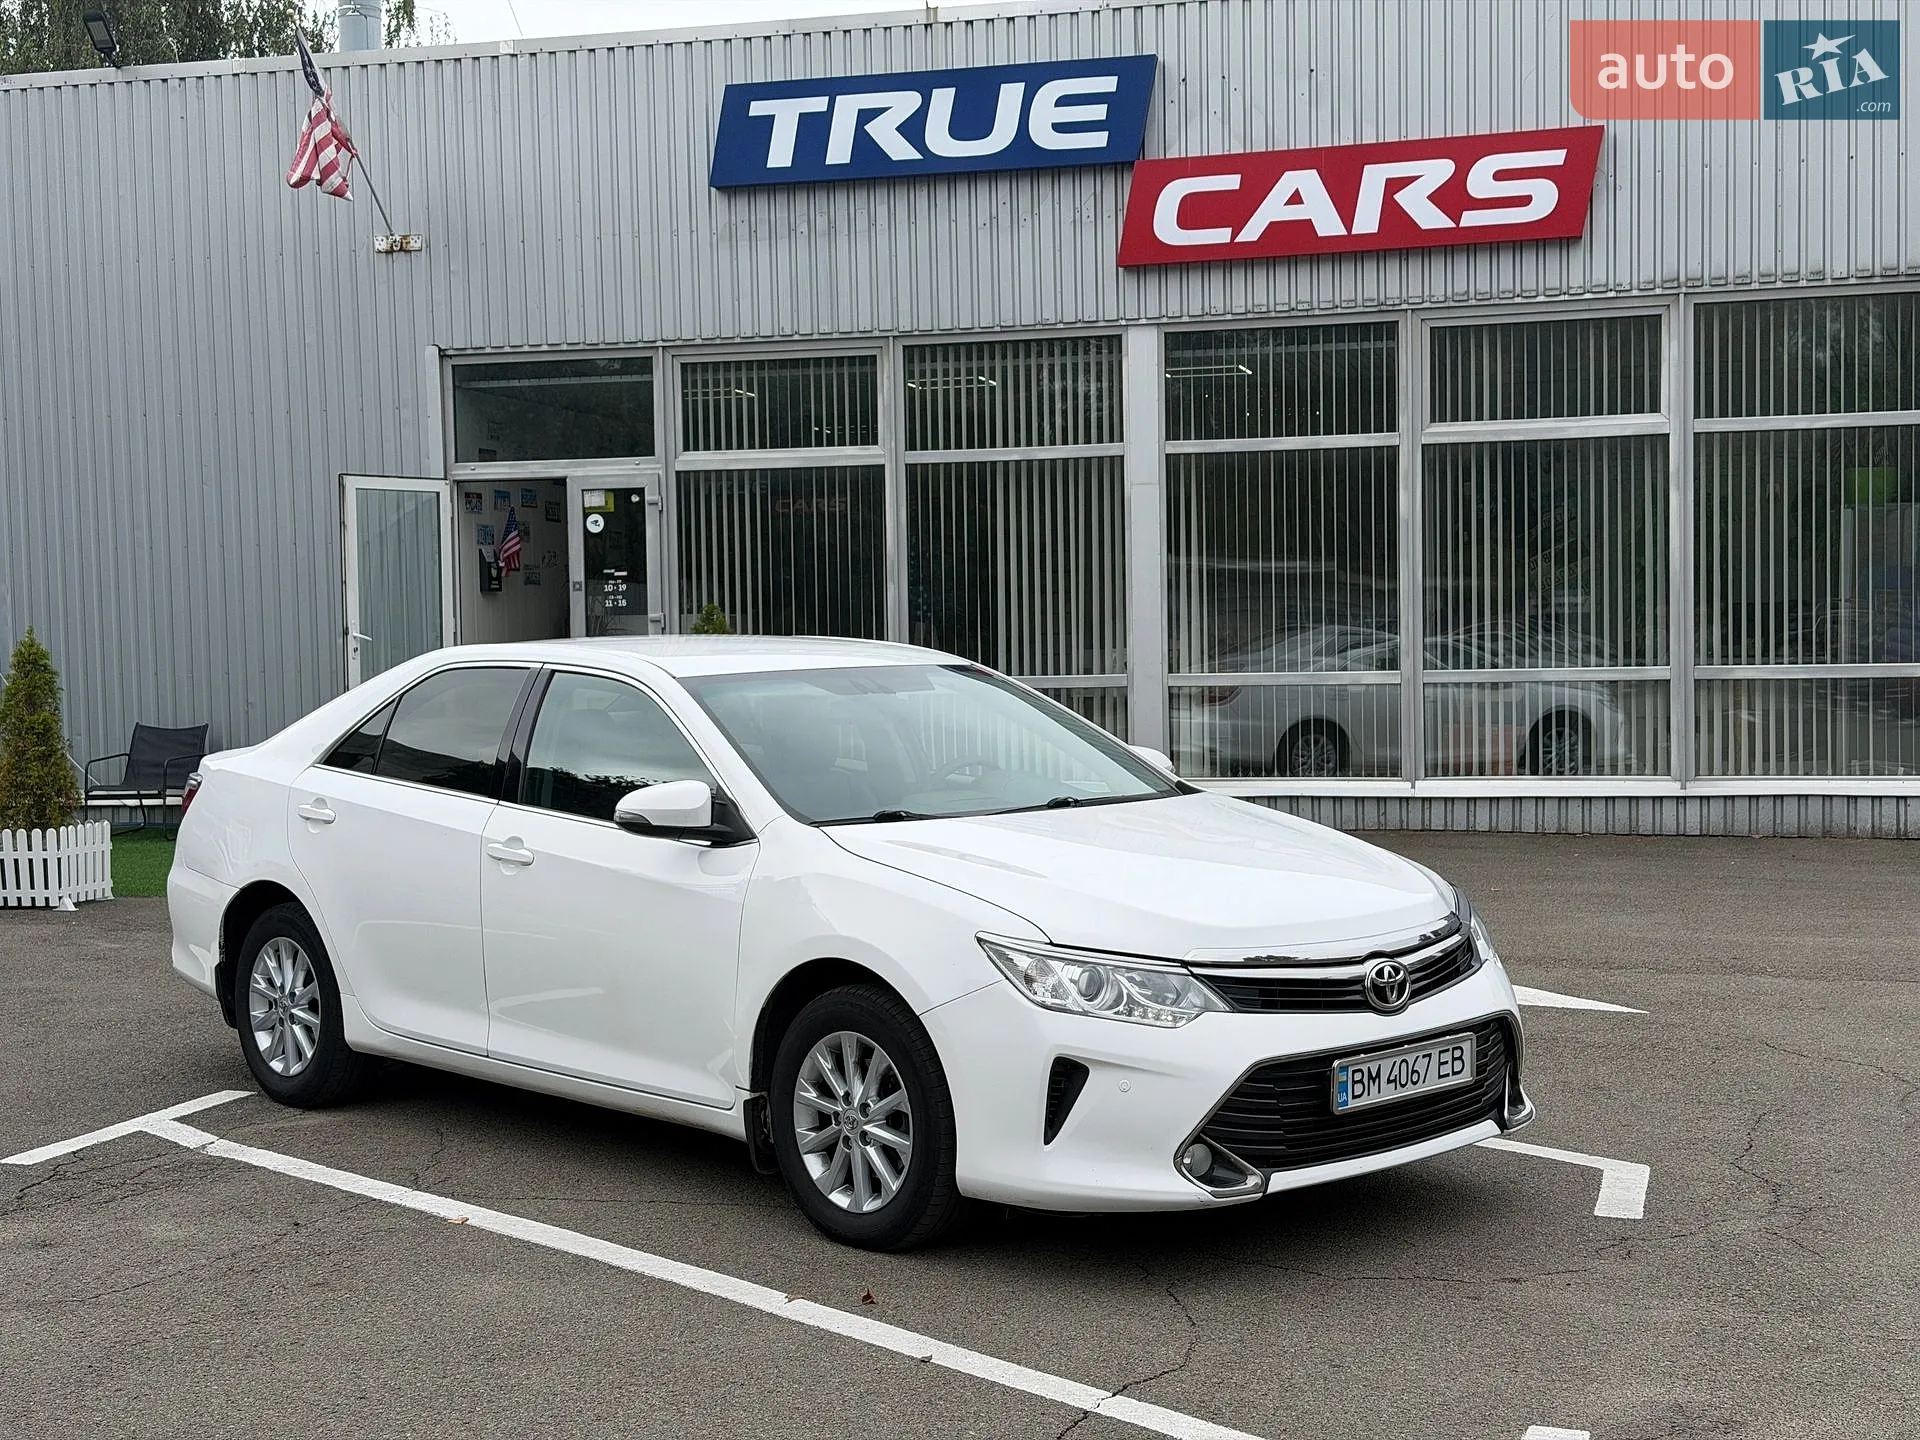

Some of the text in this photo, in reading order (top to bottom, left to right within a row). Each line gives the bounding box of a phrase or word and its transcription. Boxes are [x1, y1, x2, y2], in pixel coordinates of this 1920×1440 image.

[748, 75, 1118, 168] TRUE
[1153, 148, 1568, 246] CARS
[604, 584, 614, 592] 10
[1338, 1091, 1348, 1103] UA
[1352, 1046, 1466, 1100] BM 4067 EB
